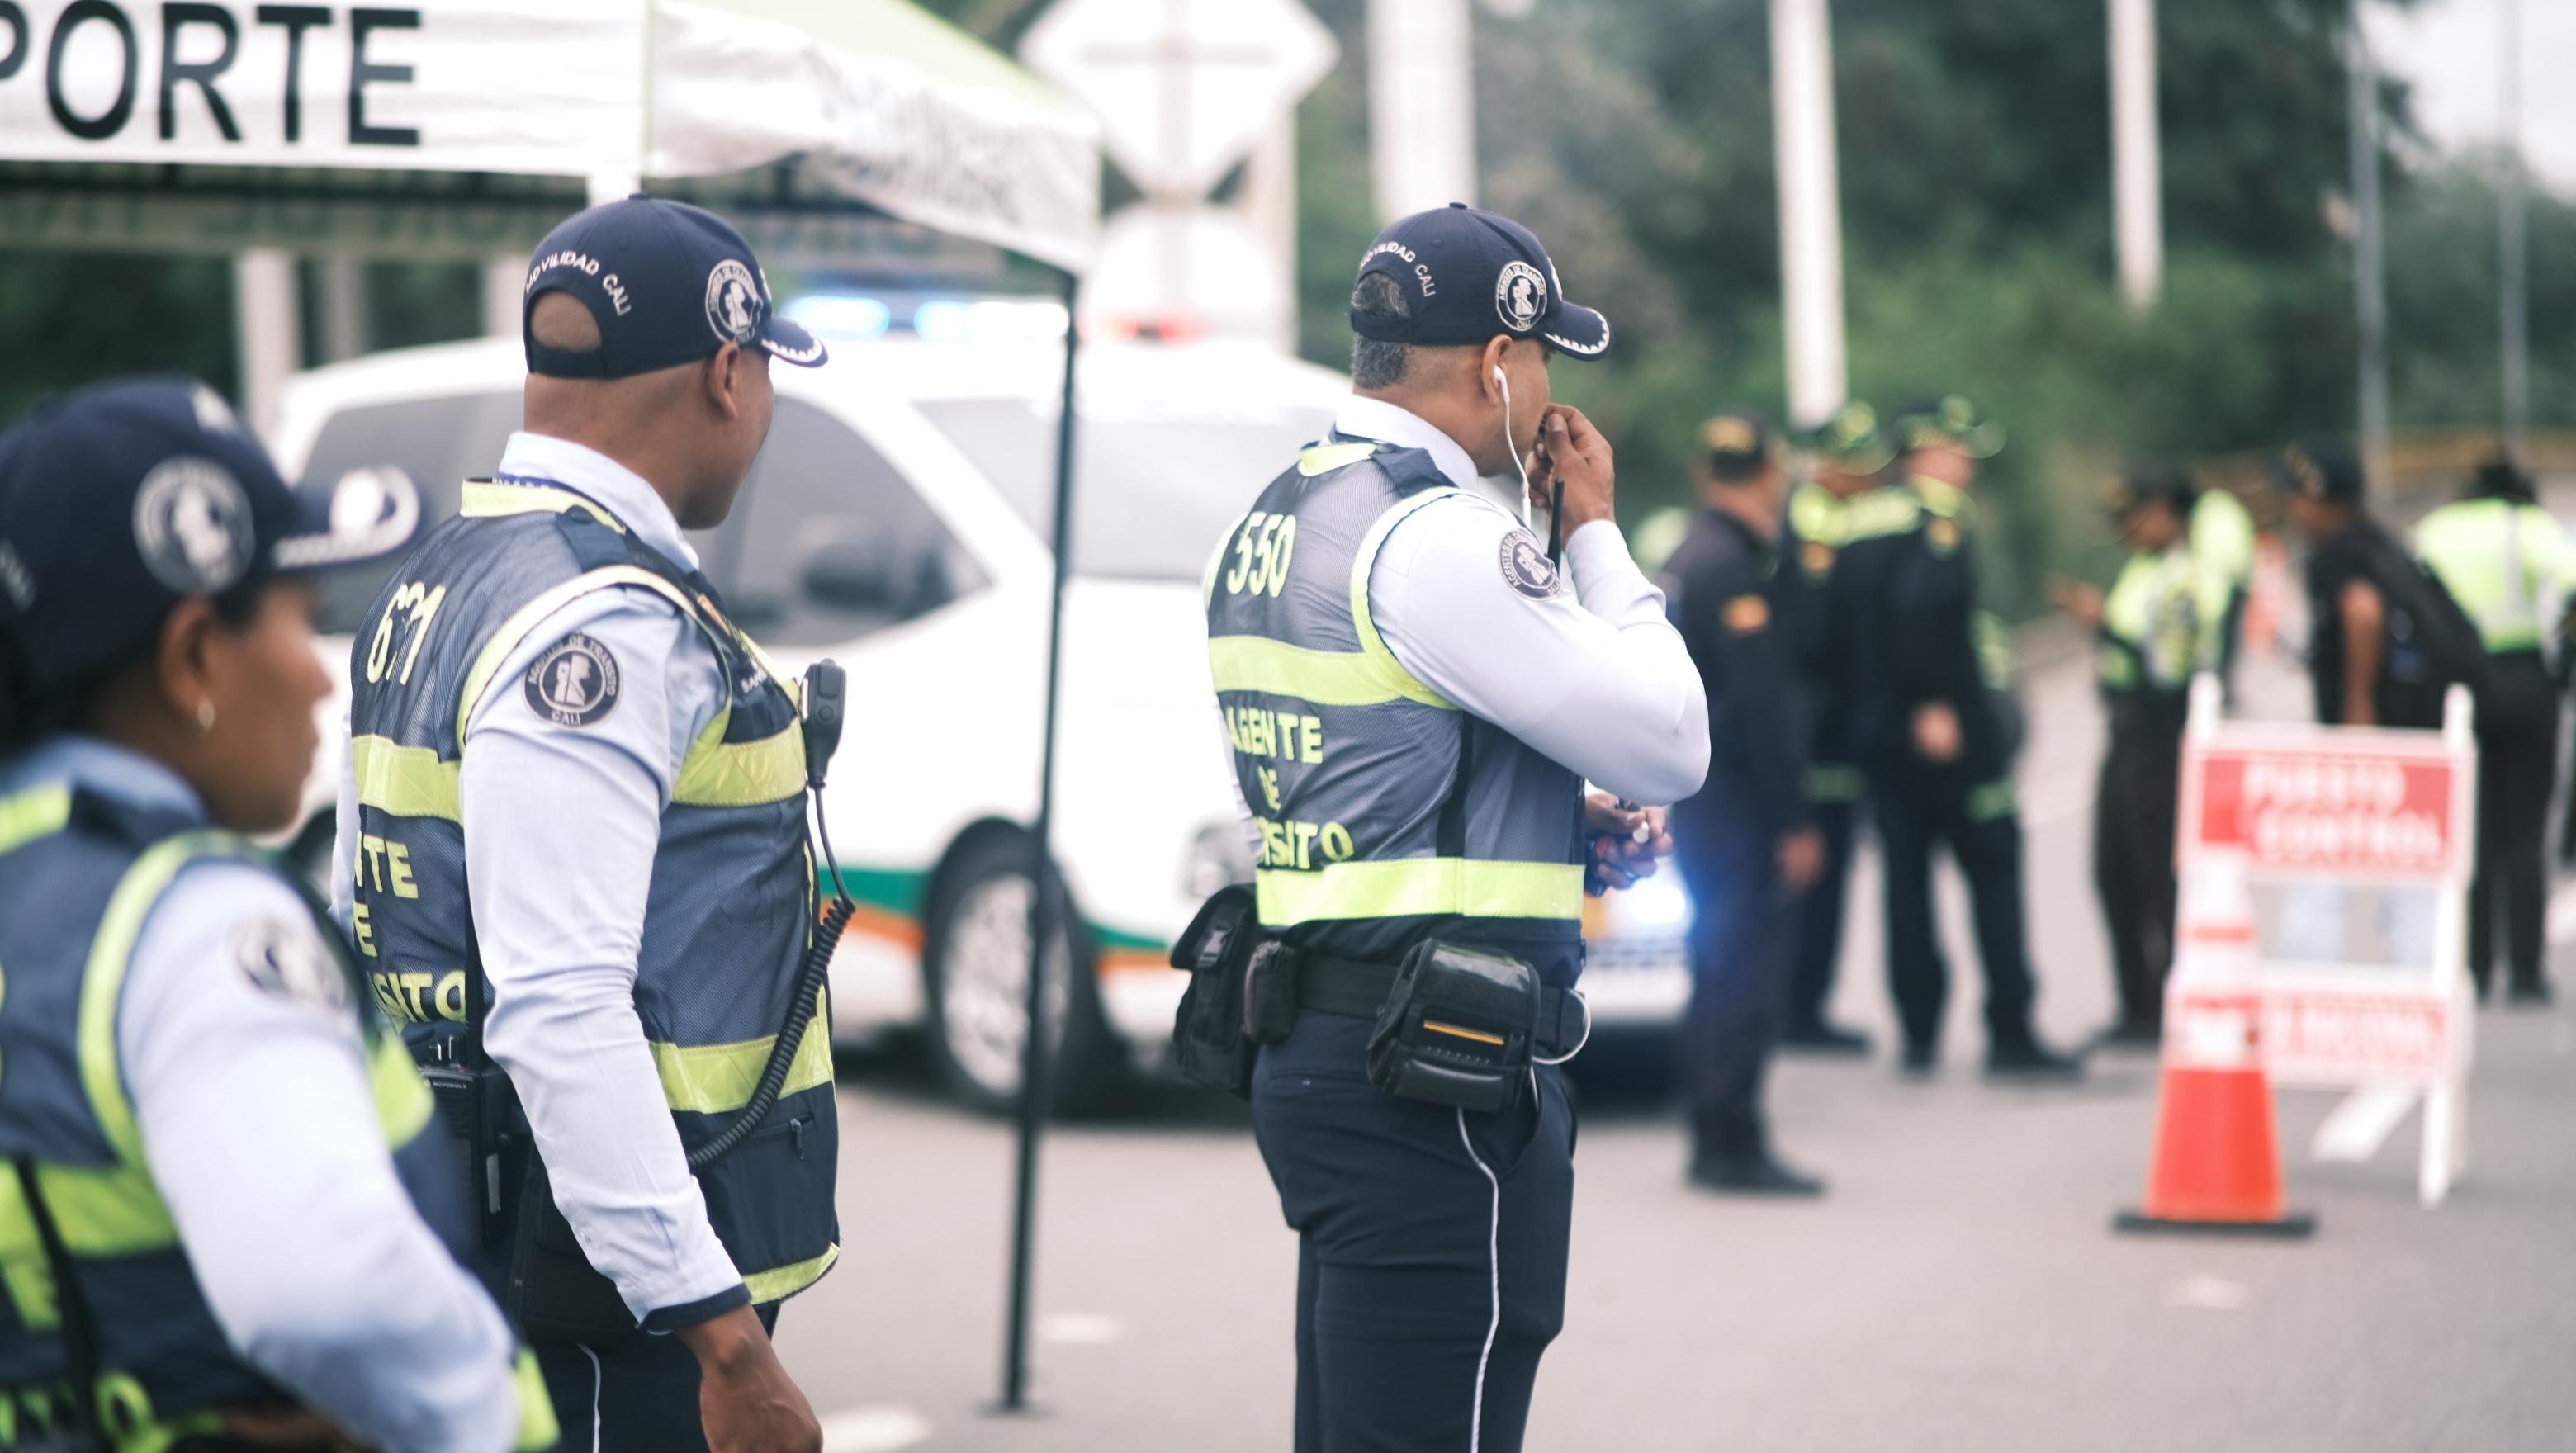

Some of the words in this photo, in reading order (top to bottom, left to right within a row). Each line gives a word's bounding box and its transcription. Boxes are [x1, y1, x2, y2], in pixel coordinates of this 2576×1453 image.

[1414, 264, 1437, 297] CALI
[1226, 510, 1297, 598] 550
[552, 711, 581, 726] CALI
